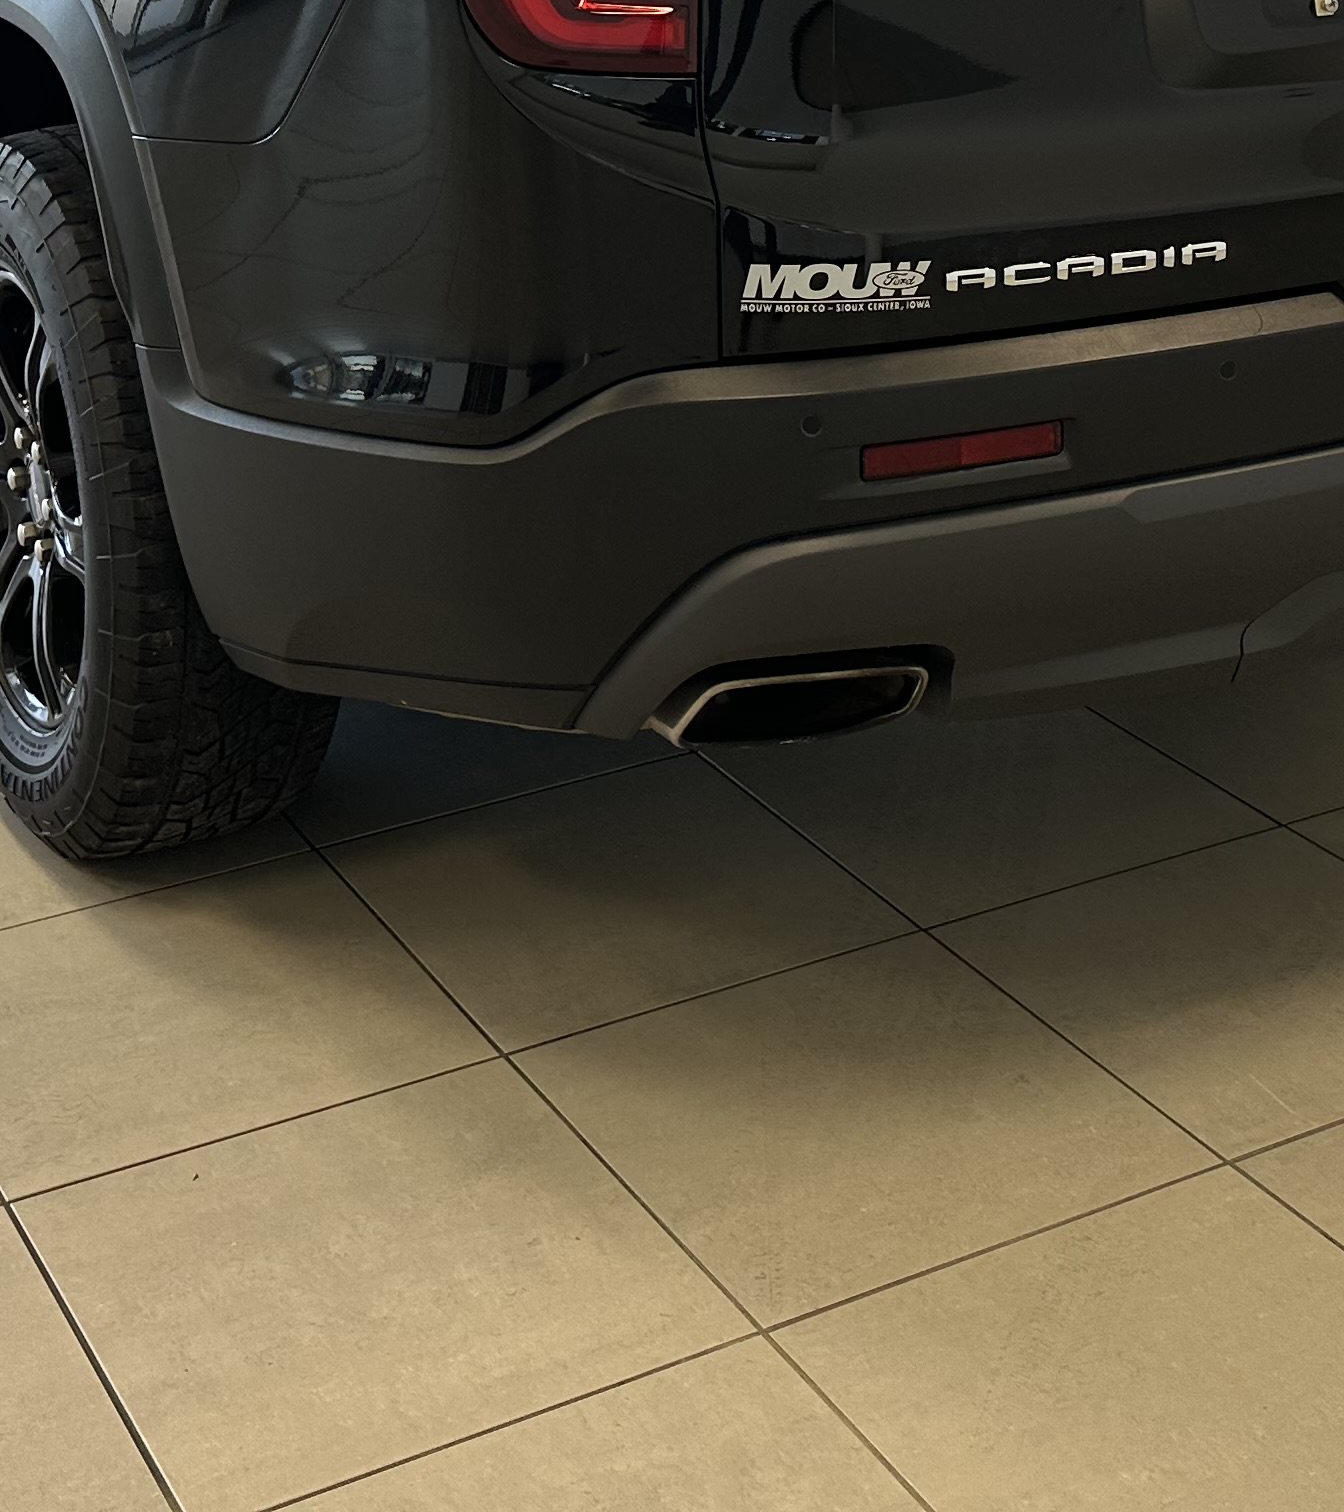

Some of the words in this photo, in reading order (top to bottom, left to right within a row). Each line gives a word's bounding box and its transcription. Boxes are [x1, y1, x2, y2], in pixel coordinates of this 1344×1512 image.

[945, 240, 1228, 292] ACADIA
[740, 303, 772, 313] MOUW
[775, 304, 810, 313] MOTOR
[812, 303, 826, 313] CO
[835, 303, 865, 312] SIOUX
[906, 299, 931, 310] IOWA
